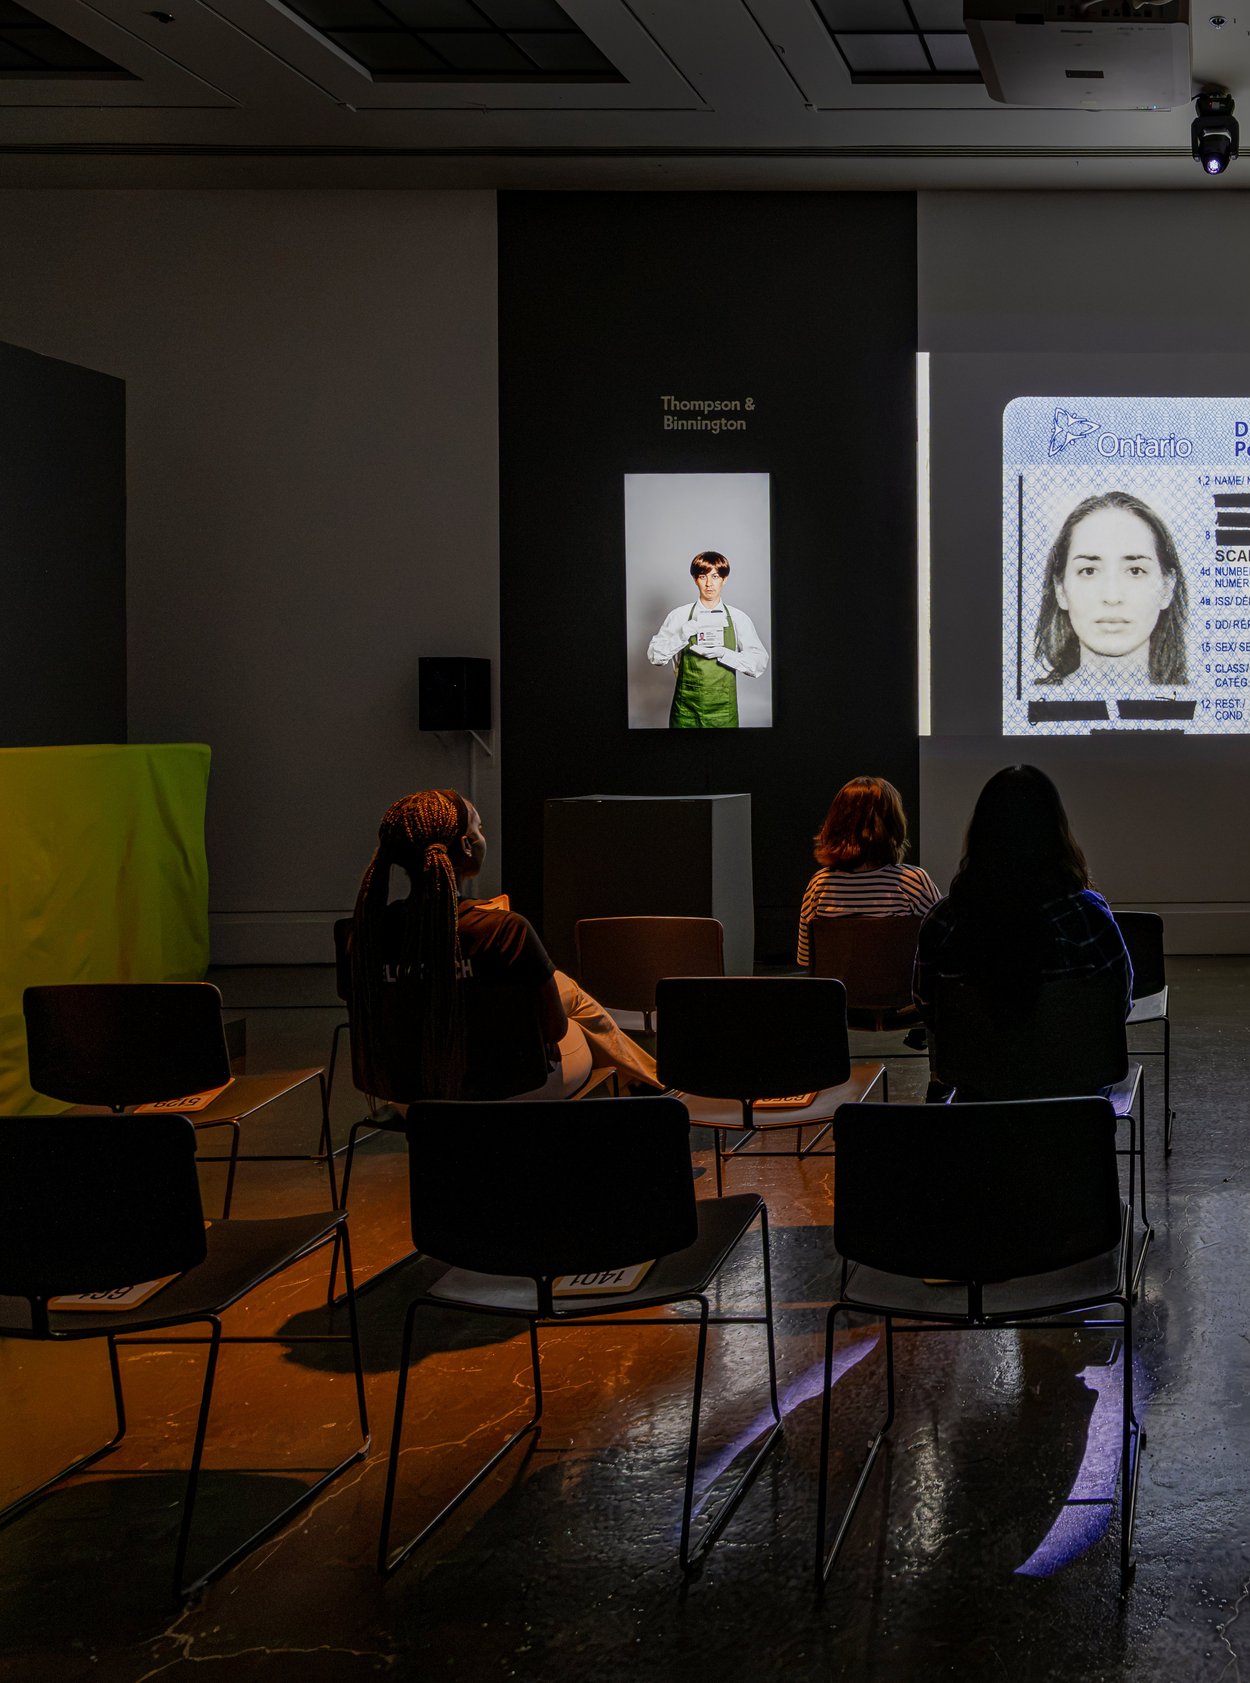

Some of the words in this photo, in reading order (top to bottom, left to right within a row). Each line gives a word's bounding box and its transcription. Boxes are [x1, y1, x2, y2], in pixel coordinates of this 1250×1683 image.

[661, 396, 740, 414] Thompson
[745, 397, 756, 411] &
[664, 415, 746, 434] Binnington
[1098, 432, 1193, 458] Ontario
[1215, 476, 1244, 486] NAME/
[1201, 642, 1210, 652] 15
[1215, 642, 1237, 652] SEX/
[1215, 663, 1249, 673] CLASS/
[1201, 699, 1210, 708] 12
